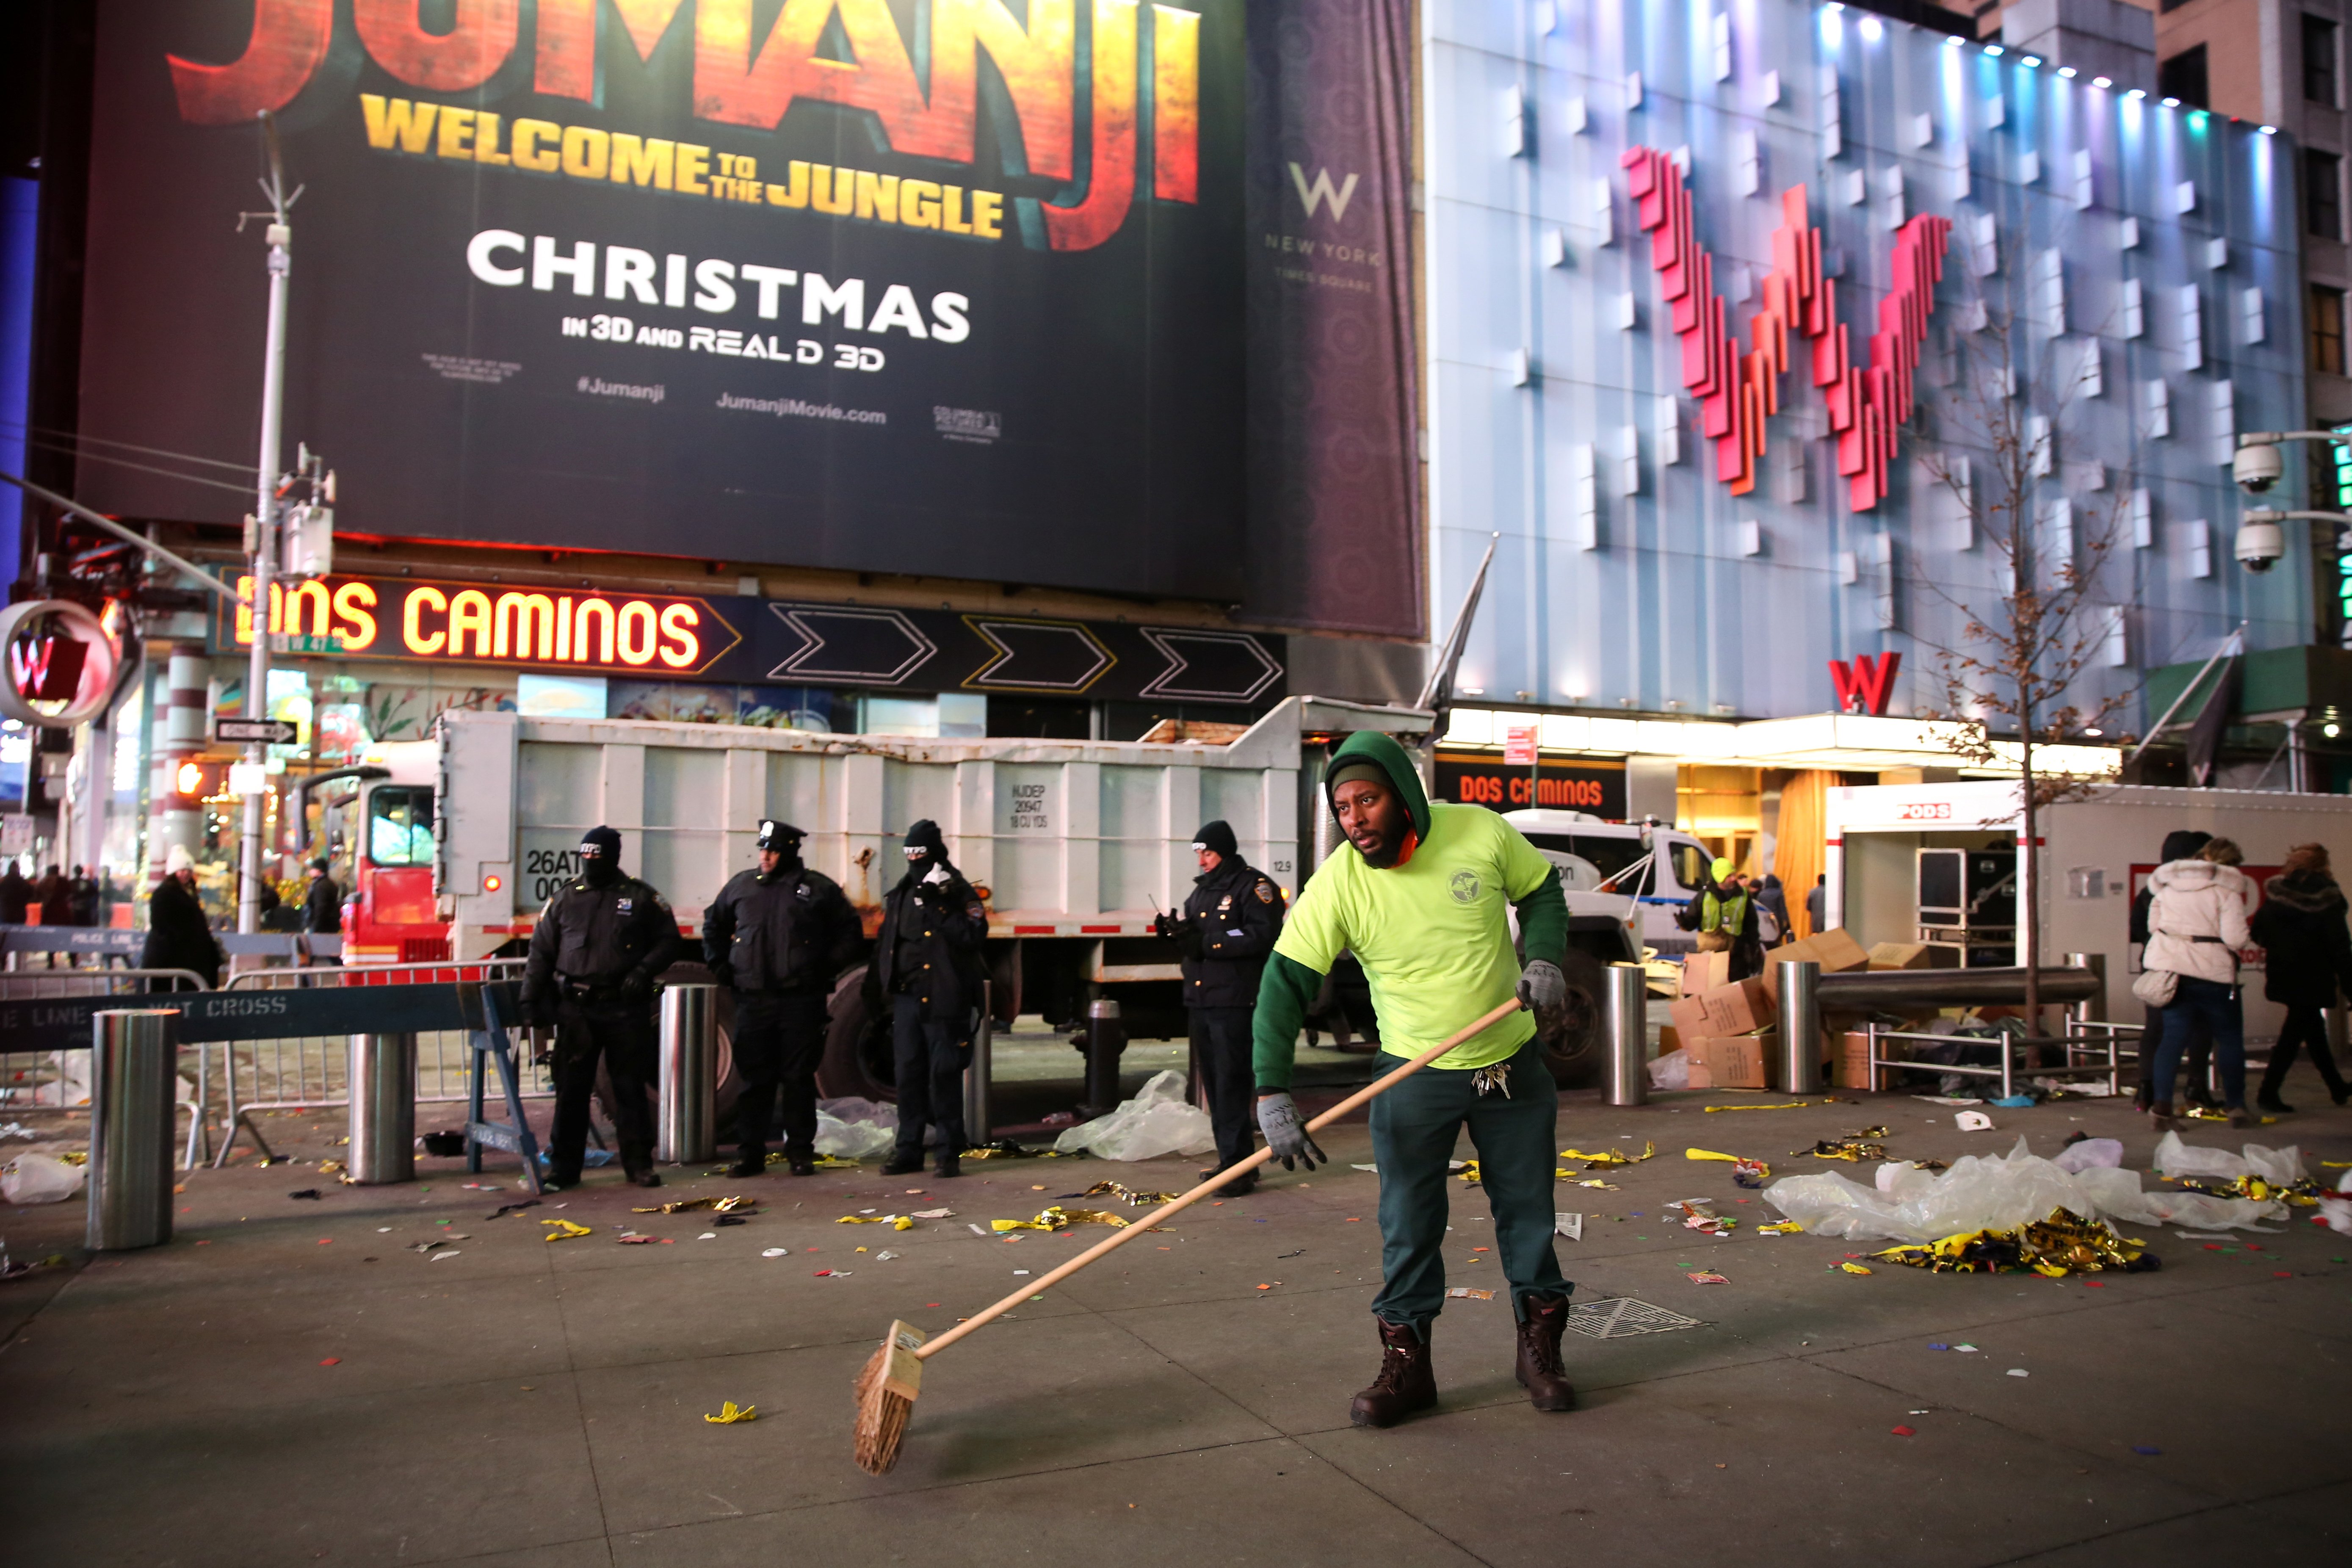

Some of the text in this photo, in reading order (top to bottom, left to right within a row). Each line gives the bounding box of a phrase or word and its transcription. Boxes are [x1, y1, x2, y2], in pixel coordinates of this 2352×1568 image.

[166, 0, 1201, 252] JUMANJI
[360, 93, 710, 196] WELCOME
[717, 152, 757, 181] TO
[710, 174, 763, 204] THE
[766, 160, 1003, 240] JUNGLE
[1288, 161, 1360, 224] W
[1265, 234, 1380, 267] NEW YORK
[466, 229, 971, 344] CHRISTMAS
[562, 316, 587, 337] IN
[590, 314, 634, 342] 3D
[636, 326, 684, 350] AND
[833, 344, 885, 372] 3D
[577, 376, 665, 404] #Jumanji
[716, 392, 886, 425] JumanjiMovie.com
[403, 586, 699, 668] CAMINOS
[1827, 651, 1902, 715] W
[1460, 775, 1603, 807] DOS CAMINOS
[1897, 804, 1949, 819] PODS
[527, 850, 580, 874] 26AT
[206, 996, 287, 1018] CROSS
